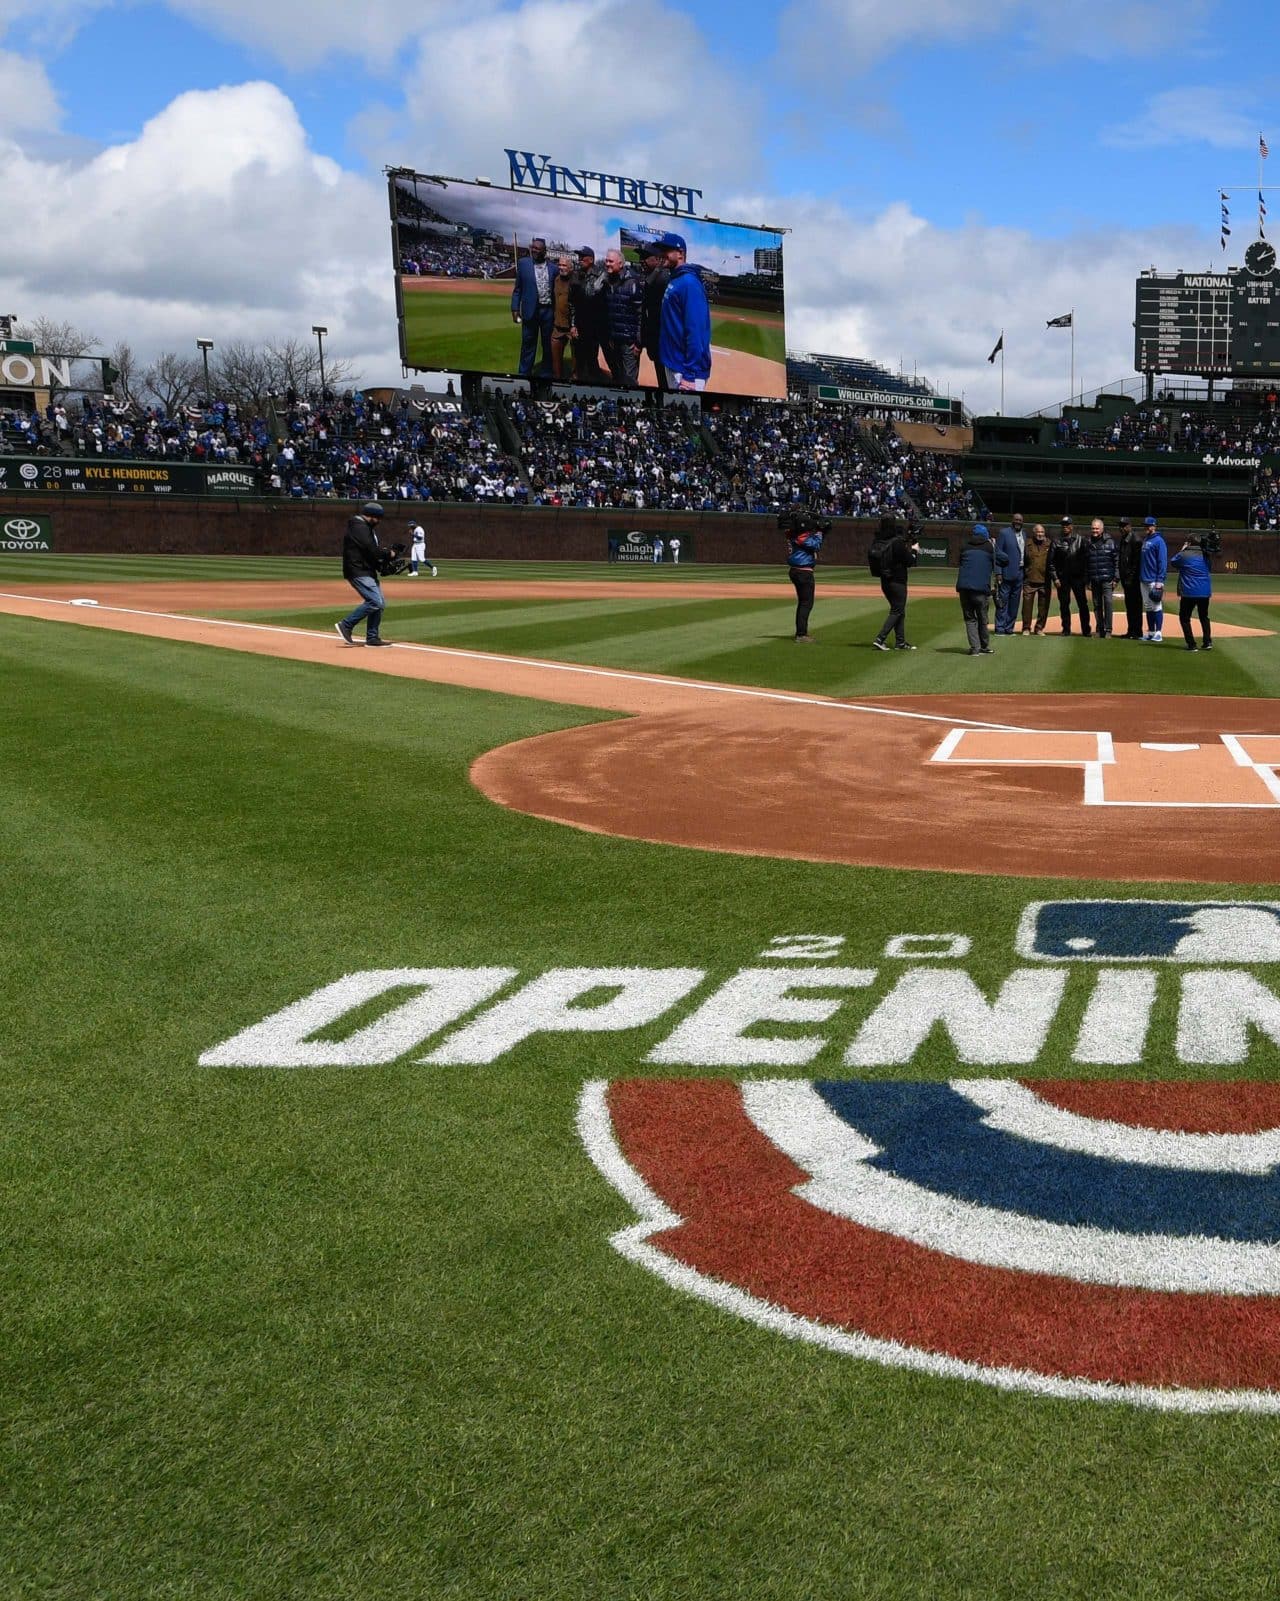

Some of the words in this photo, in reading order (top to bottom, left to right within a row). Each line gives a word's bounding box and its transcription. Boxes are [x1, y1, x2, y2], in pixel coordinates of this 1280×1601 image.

[504, 149, 702, 215] WINTRUST
[1184, 277, 1234, 287] NATIONAL
[1247, 297, 1271, 305] BATTER
[2, 355, 70, 387] ON
[837, 389, 934, 408] WRIGLEYROOFTOPS.COM
[1216, 455, 1261, 466] Advocate
[43, 466, 62, 478] 28
[65, 468, 80, 476] RHP
[85, 467, 110, 478] KYLE
[112, 468, 169, 480] HENDRICKS
[207, 472, 255, 486] MARQUEE
[24, 481, 39, 489] W-L
[72, 482, 86, 490] ERA
[1, 541, 49, 550] TOYOTA
[619, 544, 653, 554] allagh
[1225, 561, 1238, 569] 400
[760, 933, 974, 958] 20
